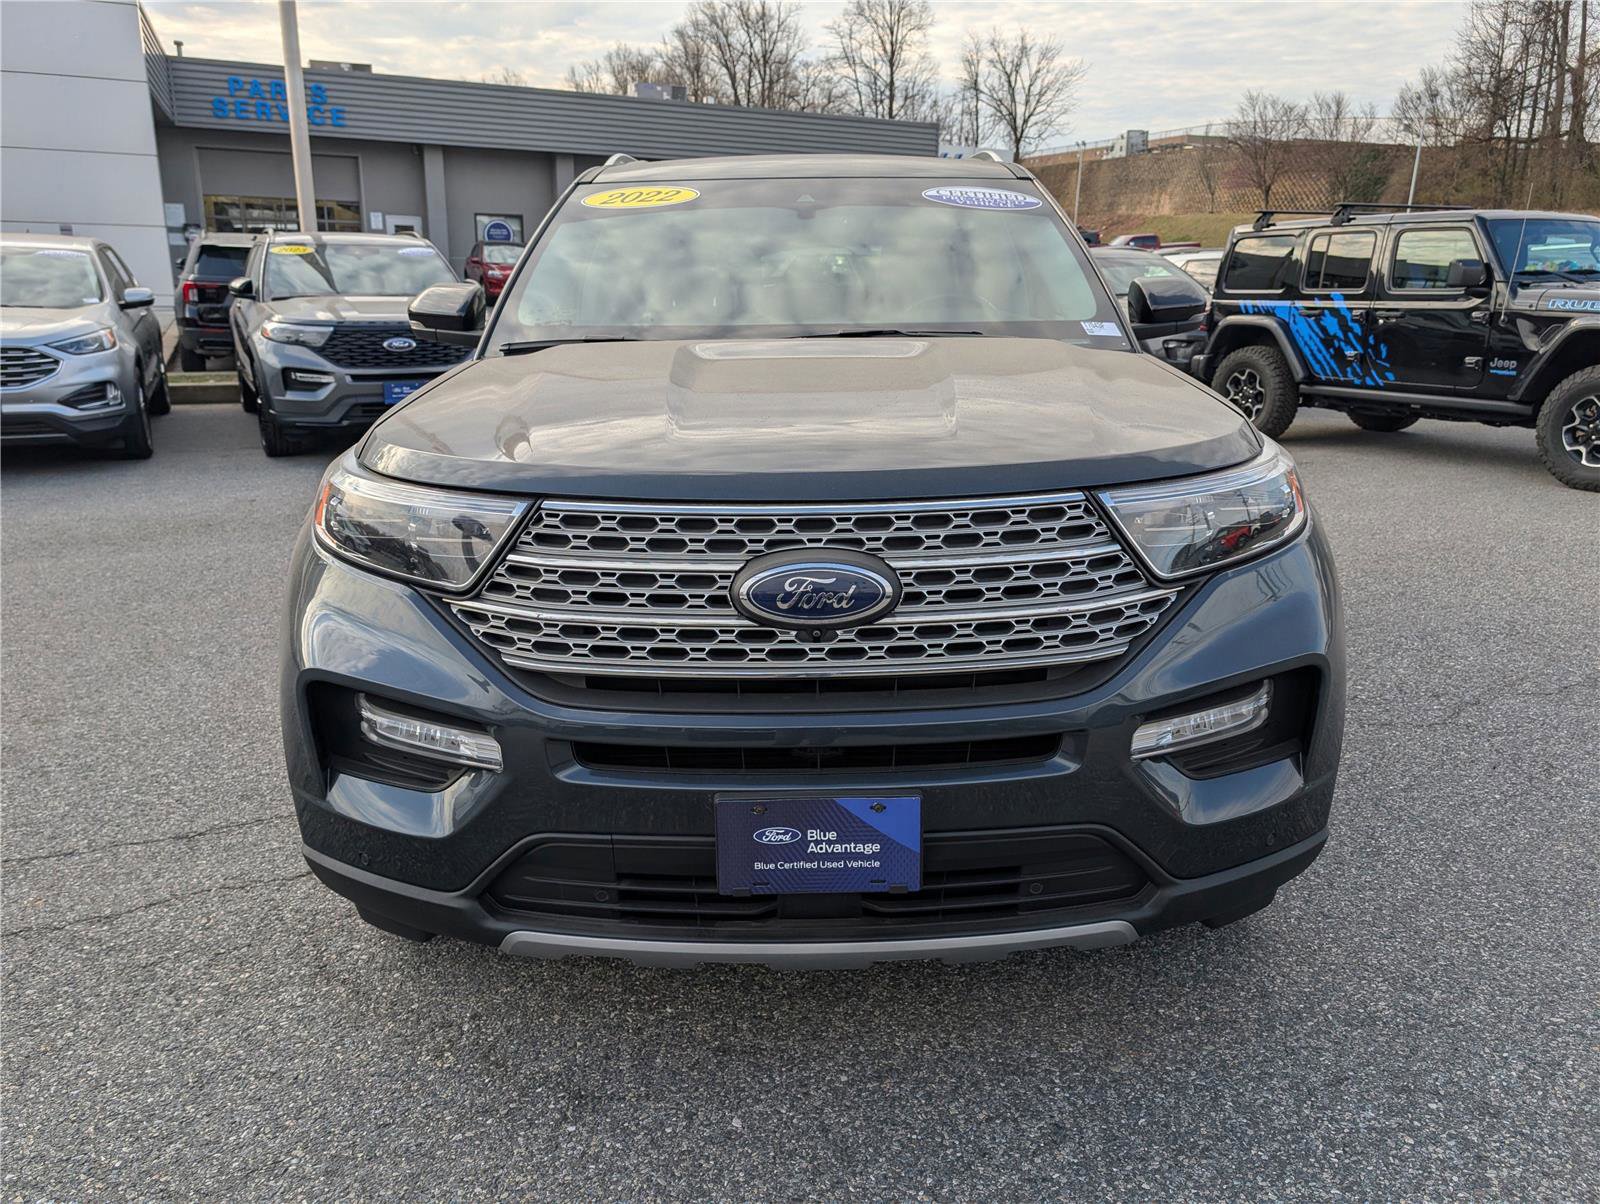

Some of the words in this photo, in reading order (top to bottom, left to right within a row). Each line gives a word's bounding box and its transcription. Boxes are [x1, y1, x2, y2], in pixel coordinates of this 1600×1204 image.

[227, 75, 328, 105] PARS
[211, 96, 347, 127] SERVCE
[600, 187, 682, 205] 2022
[1489, 357, 1517, 369] Jeep
[776, 576, 857, 610] Ford
[762, 829, 792, 842] Ford
[807, 829, 837, 841] Blue
[807, 842, 880, 855] Advantage
[754, 861, 776, 870] Blue
[777, 860, 818, 869] Certified
[819, 859, 844, 868] Used
[846, 859, 880, 868] Vehicle
